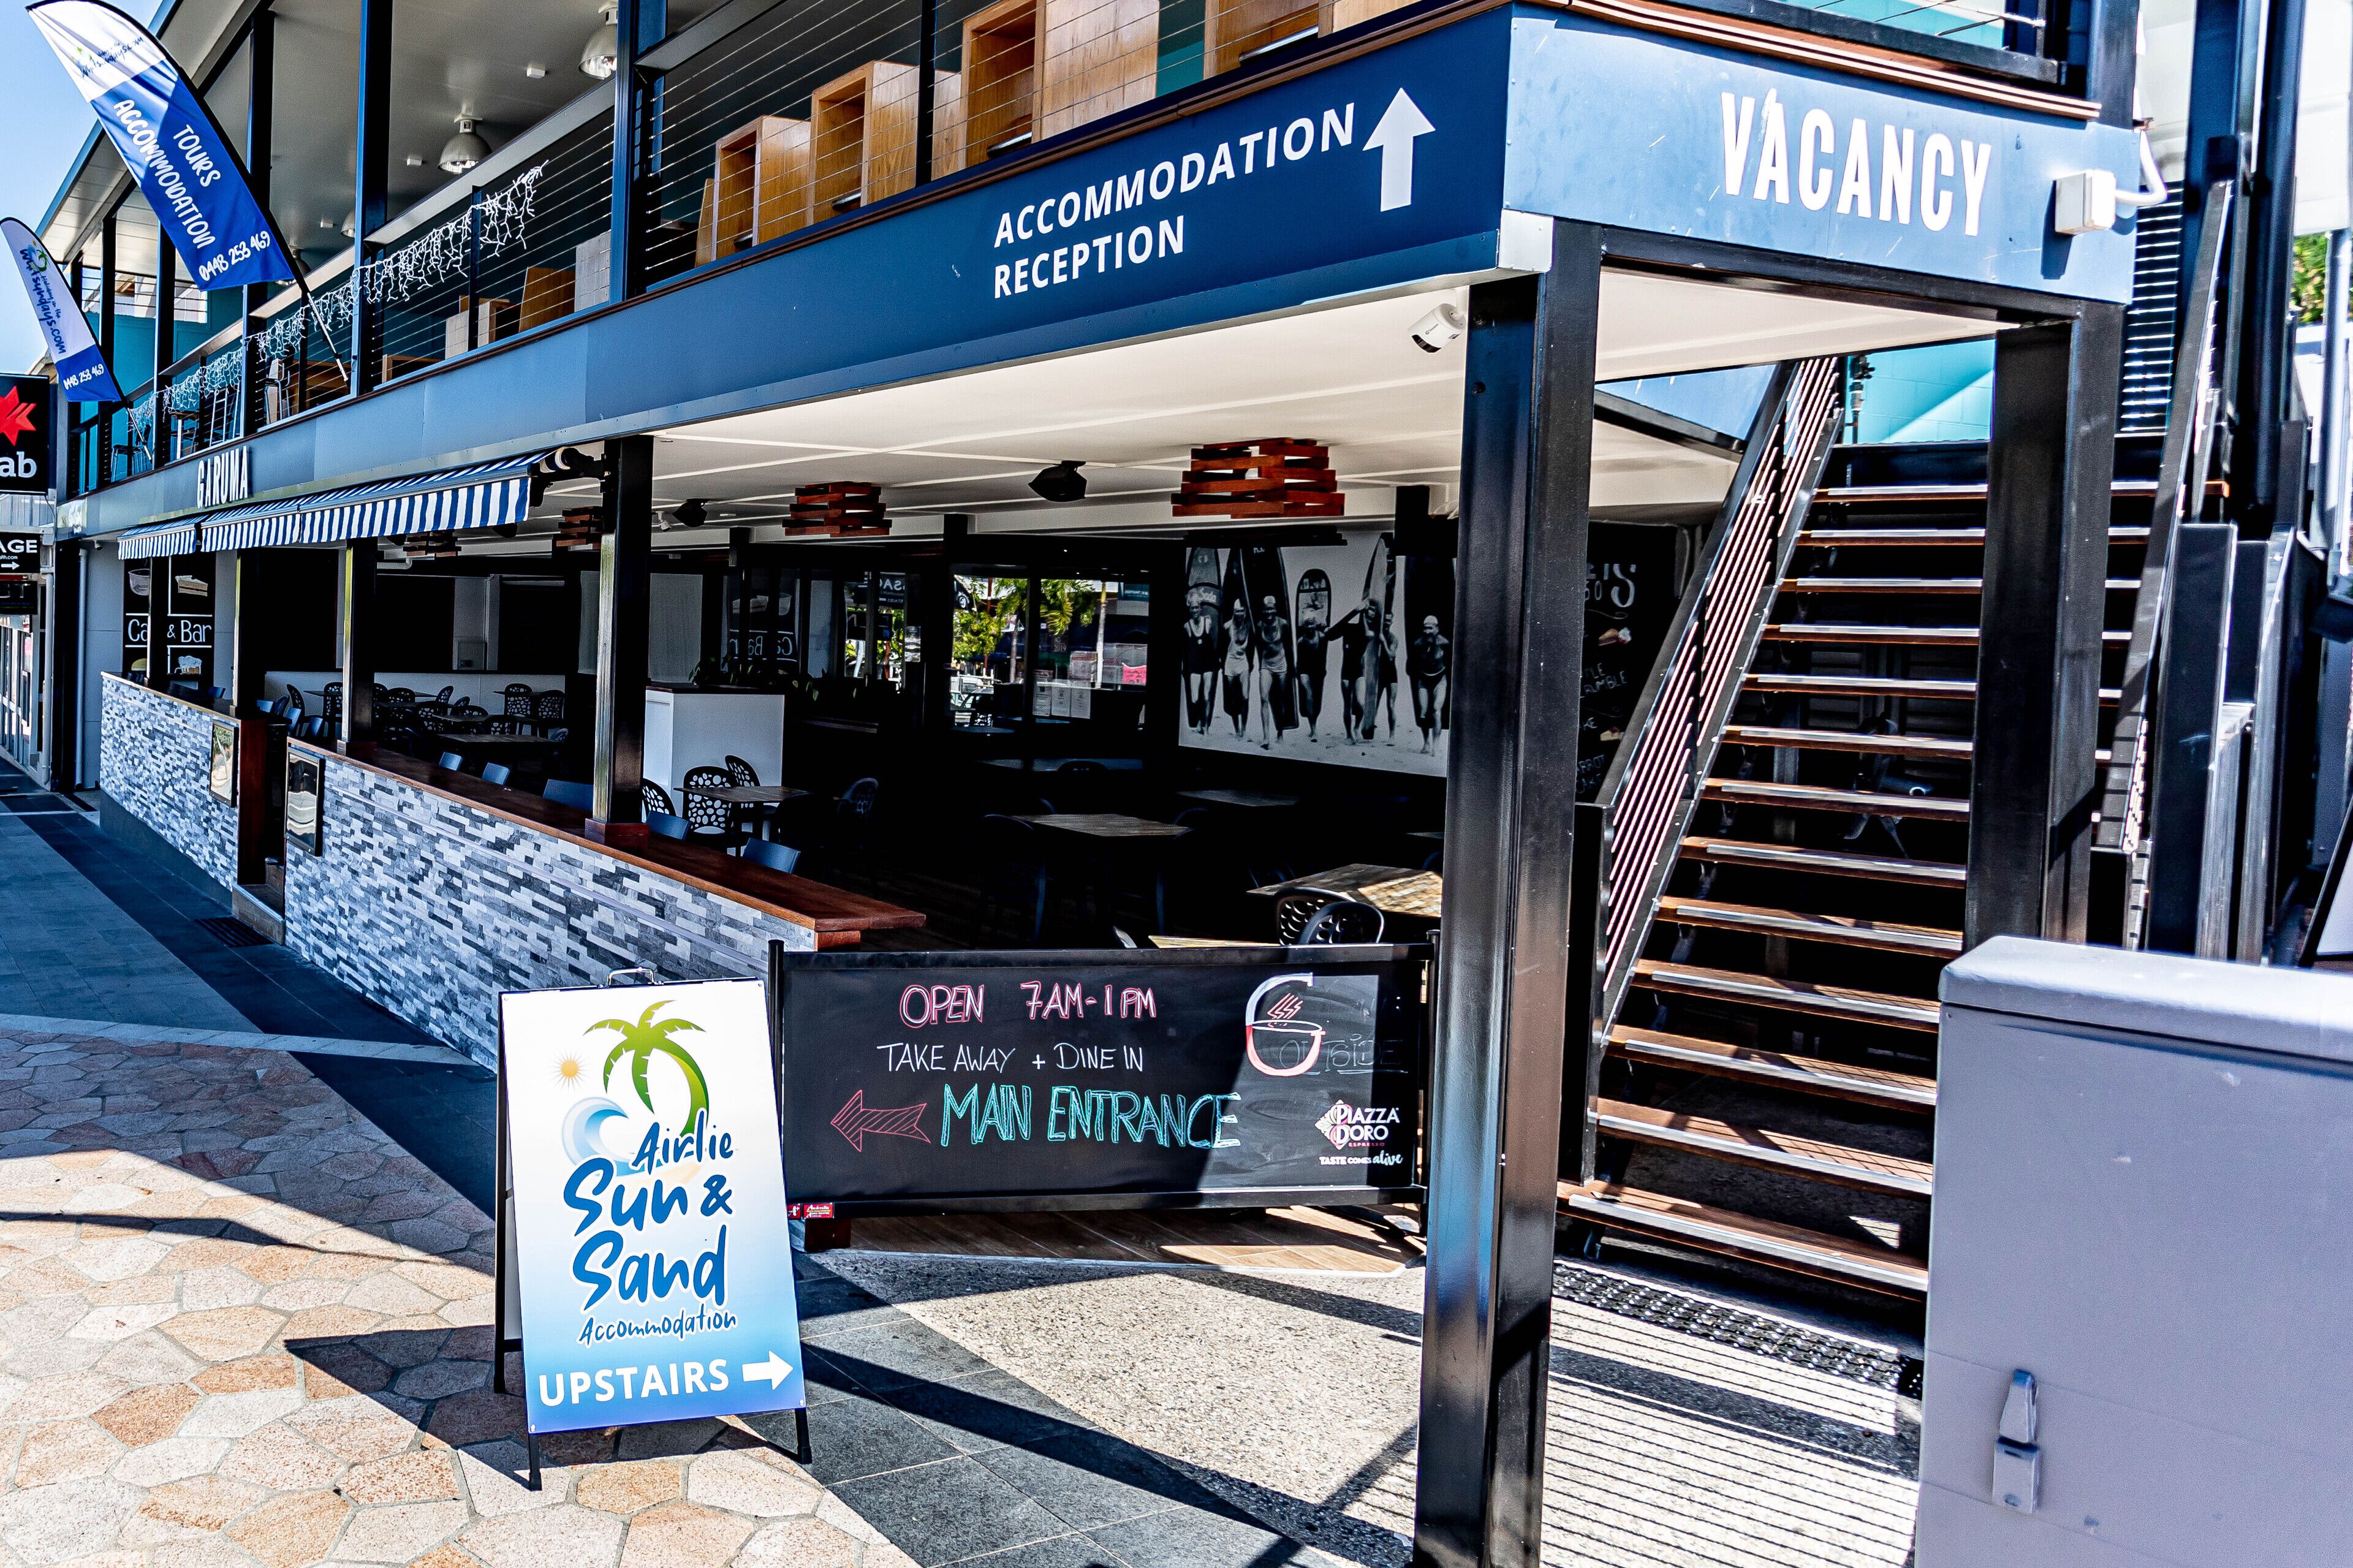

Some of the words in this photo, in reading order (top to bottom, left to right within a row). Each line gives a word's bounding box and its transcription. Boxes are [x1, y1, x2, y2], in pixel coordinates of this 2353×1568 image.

[113, 99, 216, 249] ACCOMMODATION
[173, 124, 221, 187] TOURS
[994, 102, 1355, 248] ACCOMMODATION
[1721, 89, 1992, 237] VACANCY
[199, 254, 229, 281] 0448
[229, 241, 251, 265] 253
[250, 230, 270, 251] 469
[994, 216, 1184, 298] RECEPTION
[91, 363, 104, 377] 469
[0, 451, 37, 478] ab
[197, 445, 248, 509] GARUMA
[128, 619, 148, 642] Ca
[167, 624, 176, 638] &
[180, 619, 213, 643] Bar
[900, 983, 985, 1028] OPEN
[876, 1042, 947, 1072] TAKE
[953, 1043, 1016, 1074] AWAY
[1053, 1042, 1116, 1069] DINE
[1123, 1045, 1143, 1072] IN
[632, 1110, 733, 1175] Airlie
[940, 1082, 1032, 1147] MAIN
[1047, 1085, 1242, 1149] ENTRANCE
[1336, 1104, 1401, 1125] PIAZZA
[1319, 1156, 1347, 1165] TASTE
[1372, 1149, 1403, 1165] alive
[563, 1157, 688, 1237] Sun
[700, 1174, 733, 1217] &
[572, 1224, 727, 1312] Sand
[578, 1303, 737, 1346] Accommodation
[539, 1358, 729, 1406] UPSTAIRS
